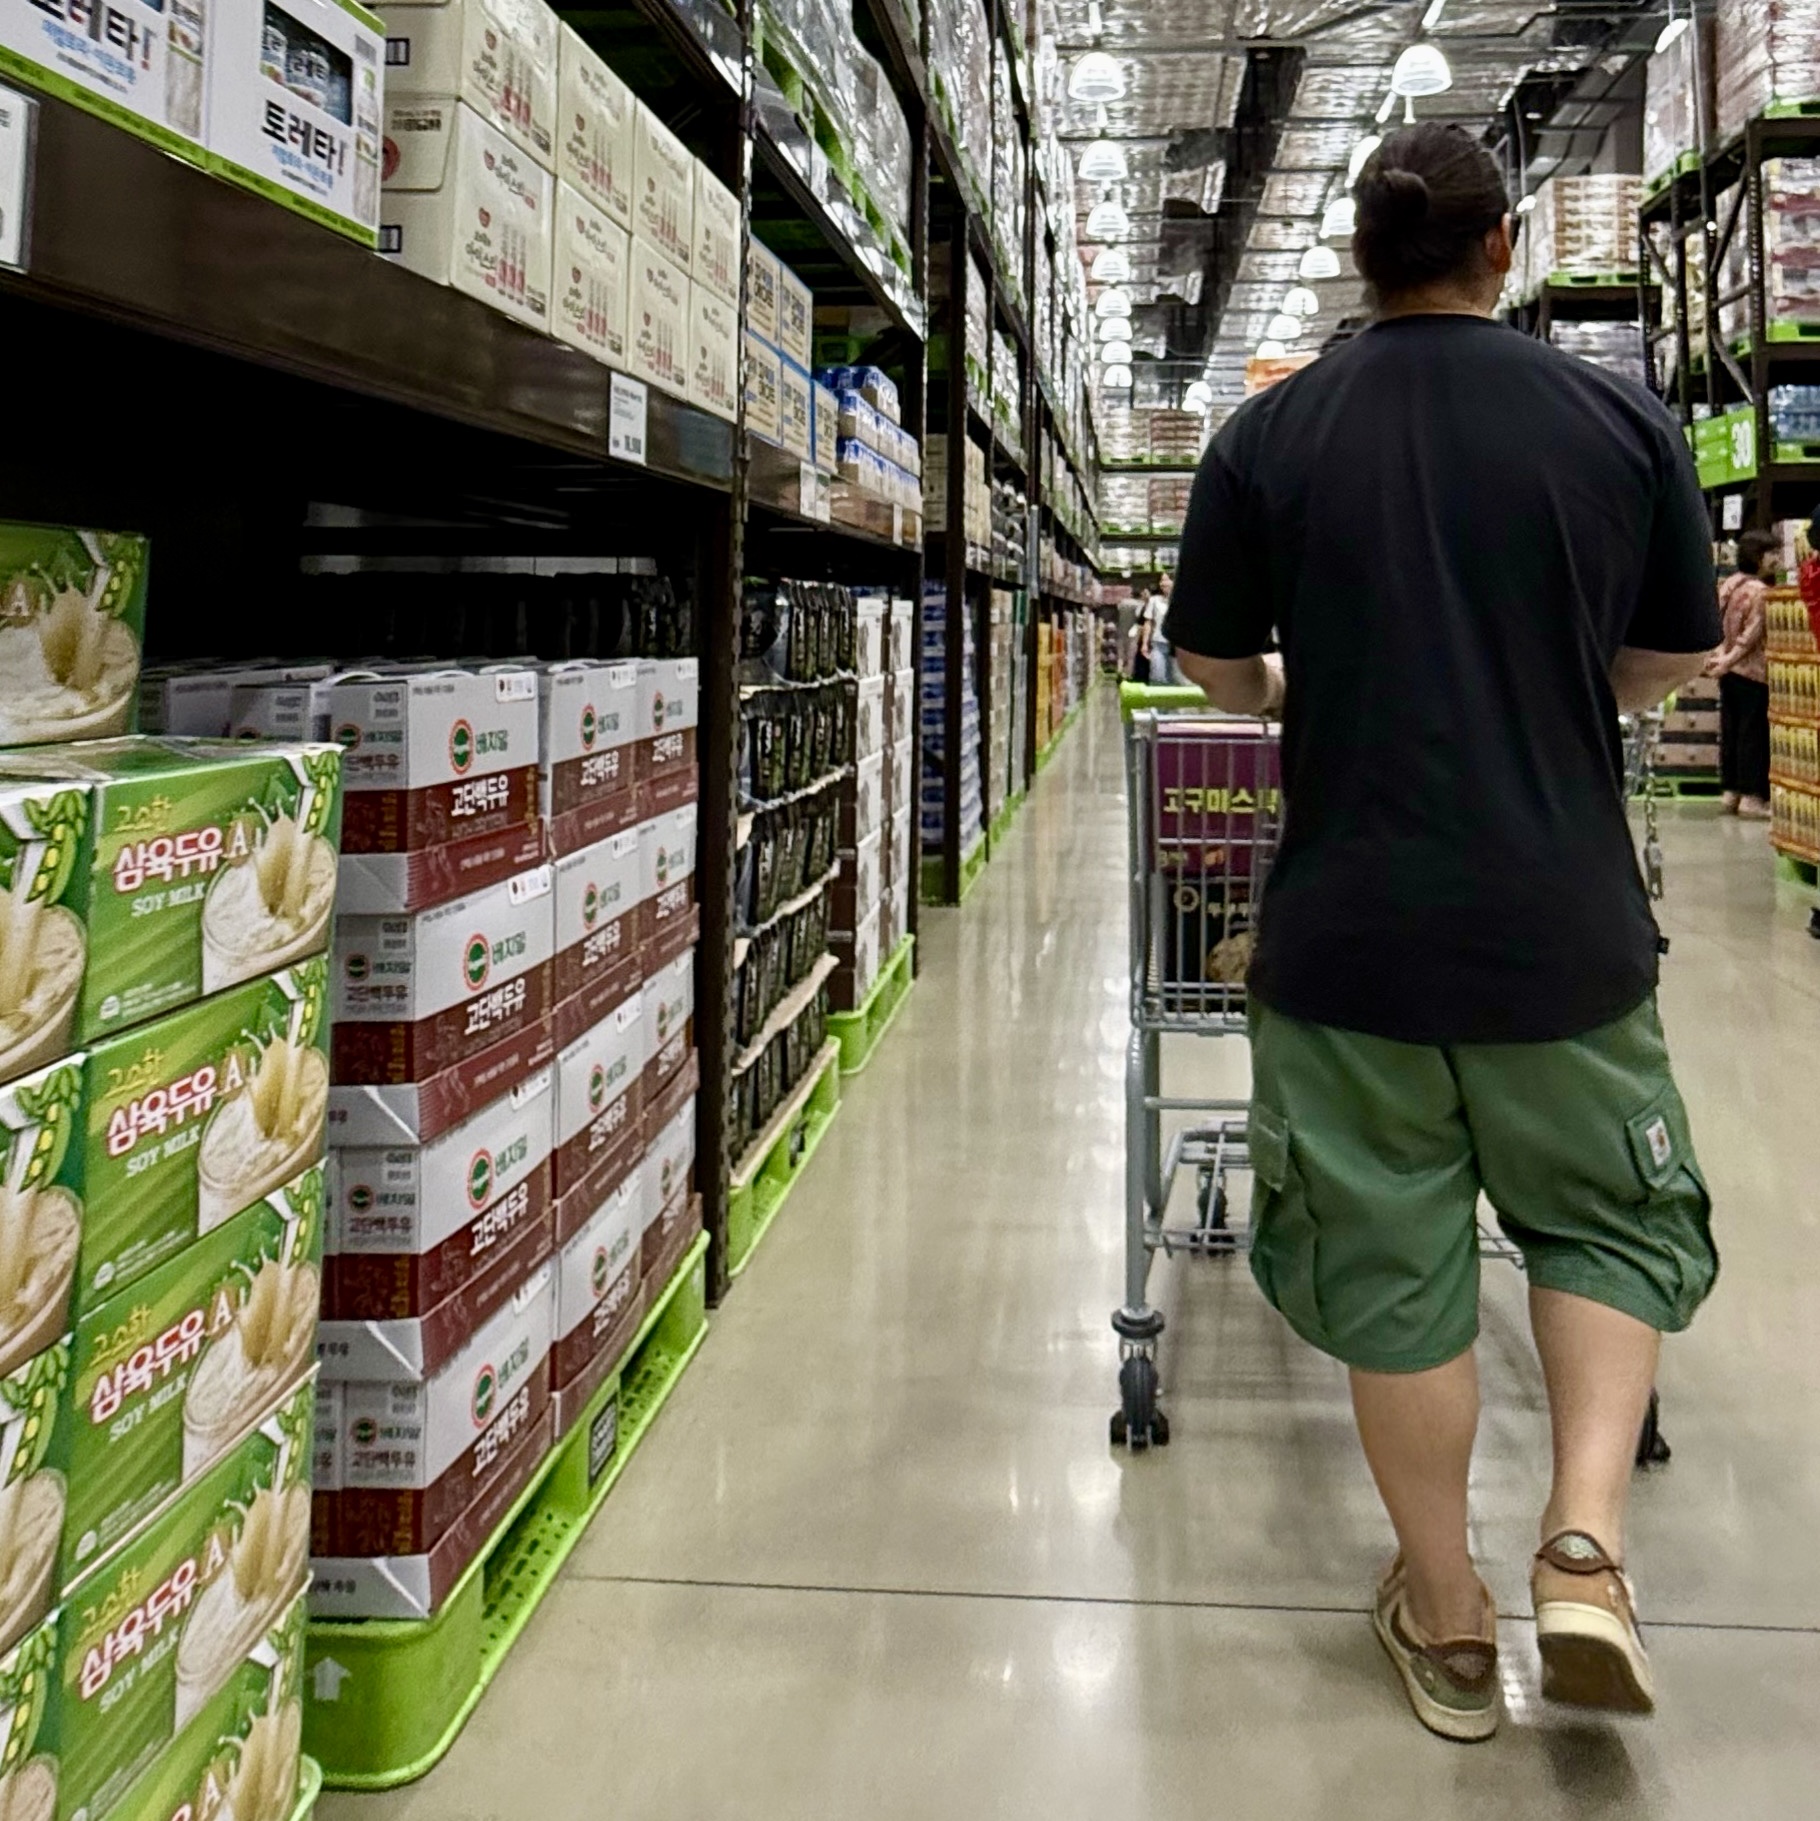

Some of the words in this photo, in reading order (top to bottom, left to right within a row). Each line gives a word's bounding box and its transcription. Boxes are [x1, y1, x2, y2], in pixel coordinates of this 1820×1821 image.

[261, 99, 346, 177] 토레타!
[450, 775, 509, 817] 고단백두유
[112, 826, 223, 893] 삼육두유
[131, 893, 166, 918] SOY
[167, 881, 206, 907] MILK
[464, 977, 526, 1036] 고단백두유
[108, 1066, 217, 1157] 삼육두유
[126, 1146, 161, 1179] SOY
[163, 1124, 200, 1159] MILK
[470, 1182, 529, 1257] 고단백두유
[91, 1309, 205, 1425] 삼육두유
[109, 1403, 146, 1442] SOY
[147, 1371, 188, 1415] MILK
[472, 1386, 530, 1478] 고단백두유
[80, 1558, 198, 1700] 삼육두유
[100, 1667, 137, 1715] SOY
[140, 1625, 180, 1677] MILK
